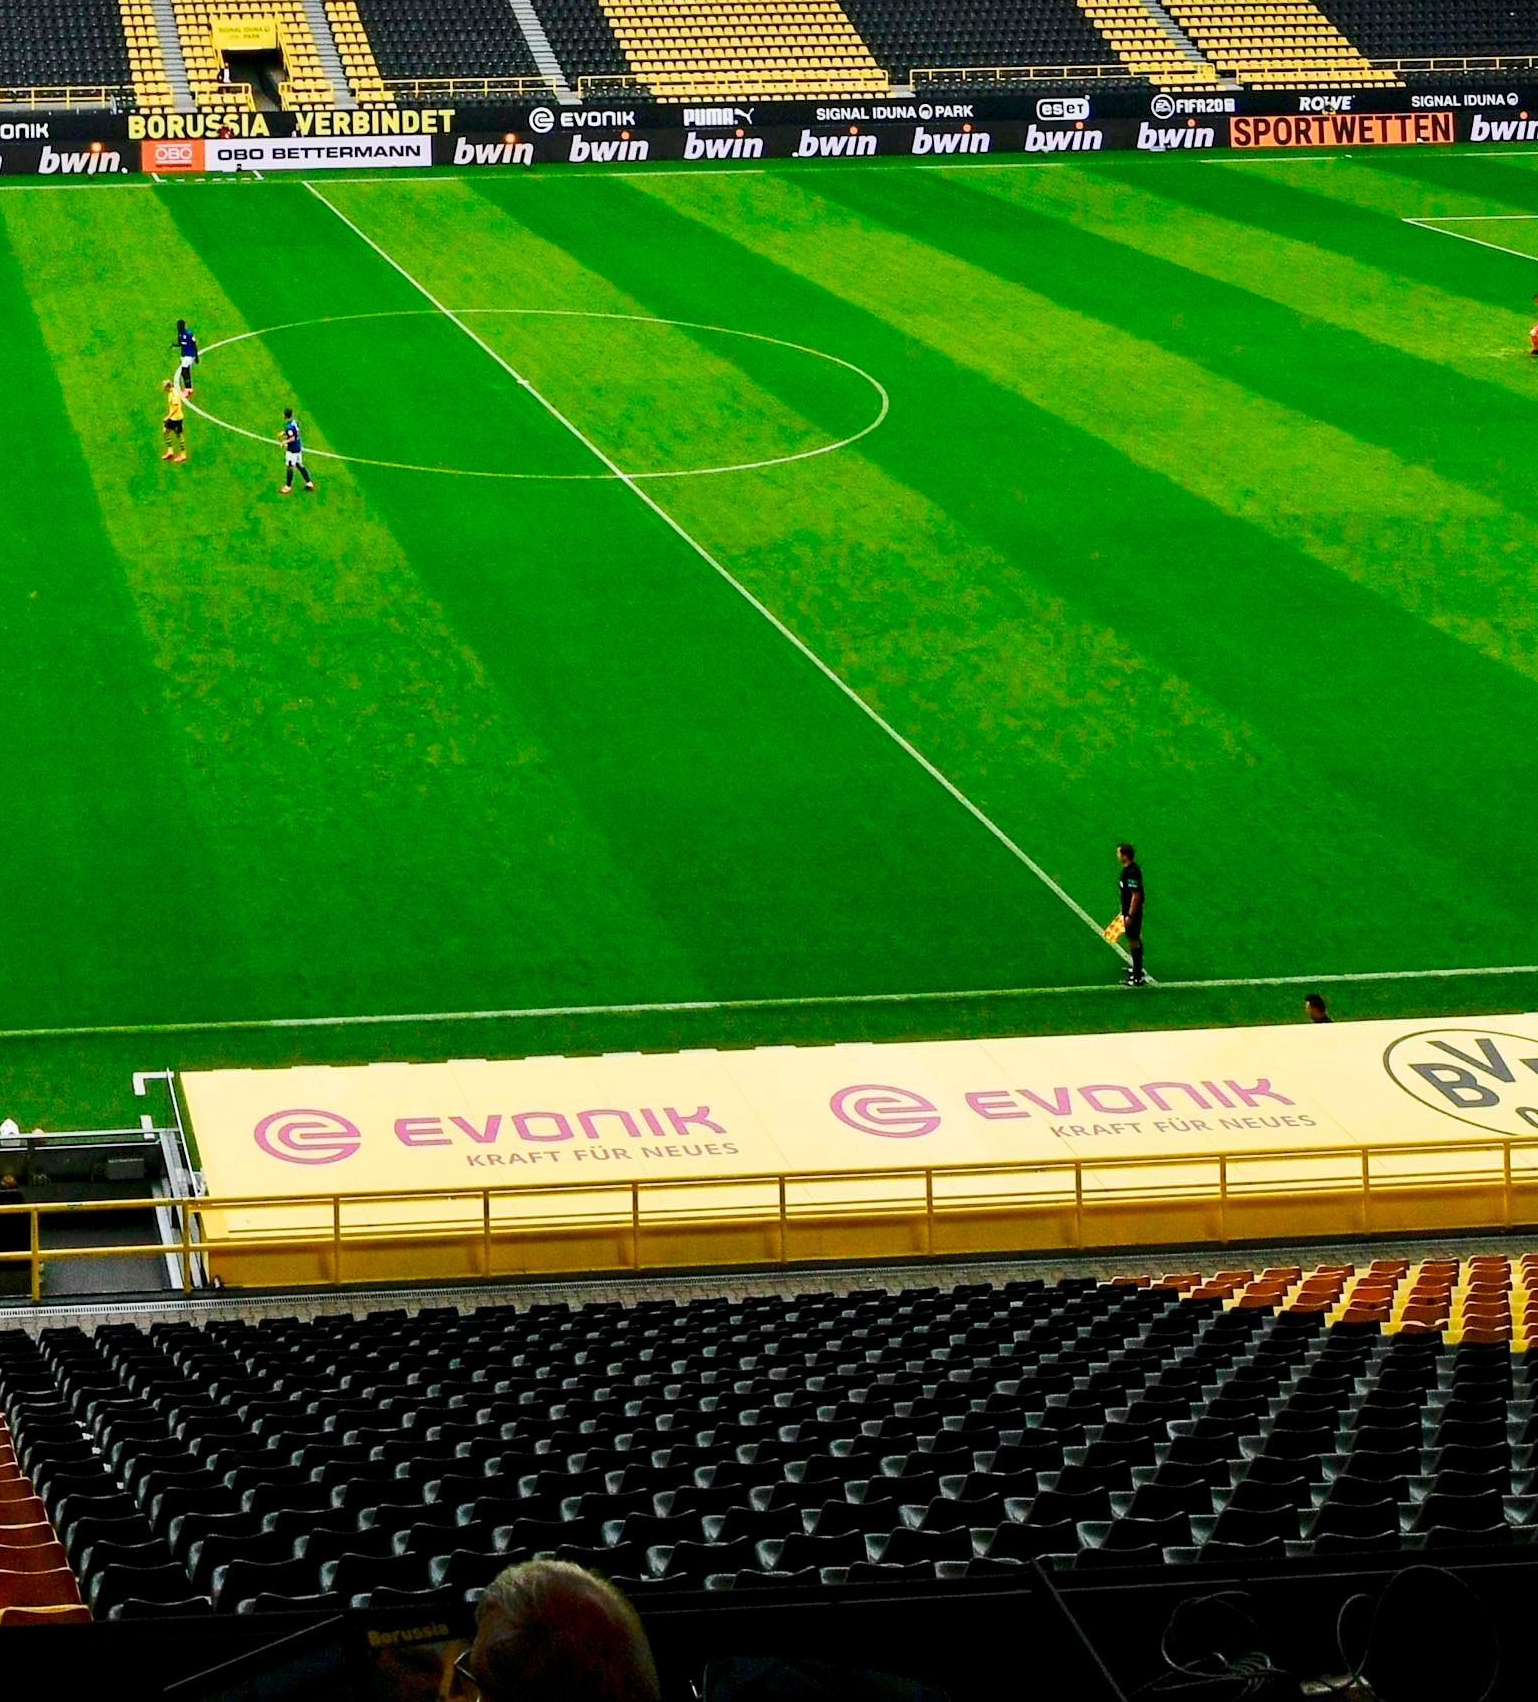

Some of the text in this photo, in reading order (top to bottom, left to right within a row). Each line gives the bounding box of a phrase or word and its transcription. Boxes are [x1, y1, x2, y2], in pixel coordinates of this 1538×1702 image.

[816, 104, 973, 121] SIGNAL IDUNA PARK
[1411, 93, 1506, 108] SIGNAL IDUNA
[127, 109, 456, 140] BORUSSIA VERBINDET
[561, 110, 635, 128] EVONIK
[1136, 117, 1215, 149] bwin
[1233, 113, 1451, 146] SPORTWETTEN
[454, 132, 534, 166] bwin
[569, 131, 650, 162] bwin
[683, 128, 764, 160] bwin
[1024, 120, 1103, 152] bwin
[37, 141, 121, 174] bwin
[217, 145, 422, 161] OBO BETTERMANN
[971, 1076, 1297, 1121] EVONIK
[397, 1104, 729, 1147] EVONIK
[1050, 1110, 1316, 1140] KRAFT FÜR NEUES
[465, 1139, 739, 1170] KRAFT FÜR NEUES
